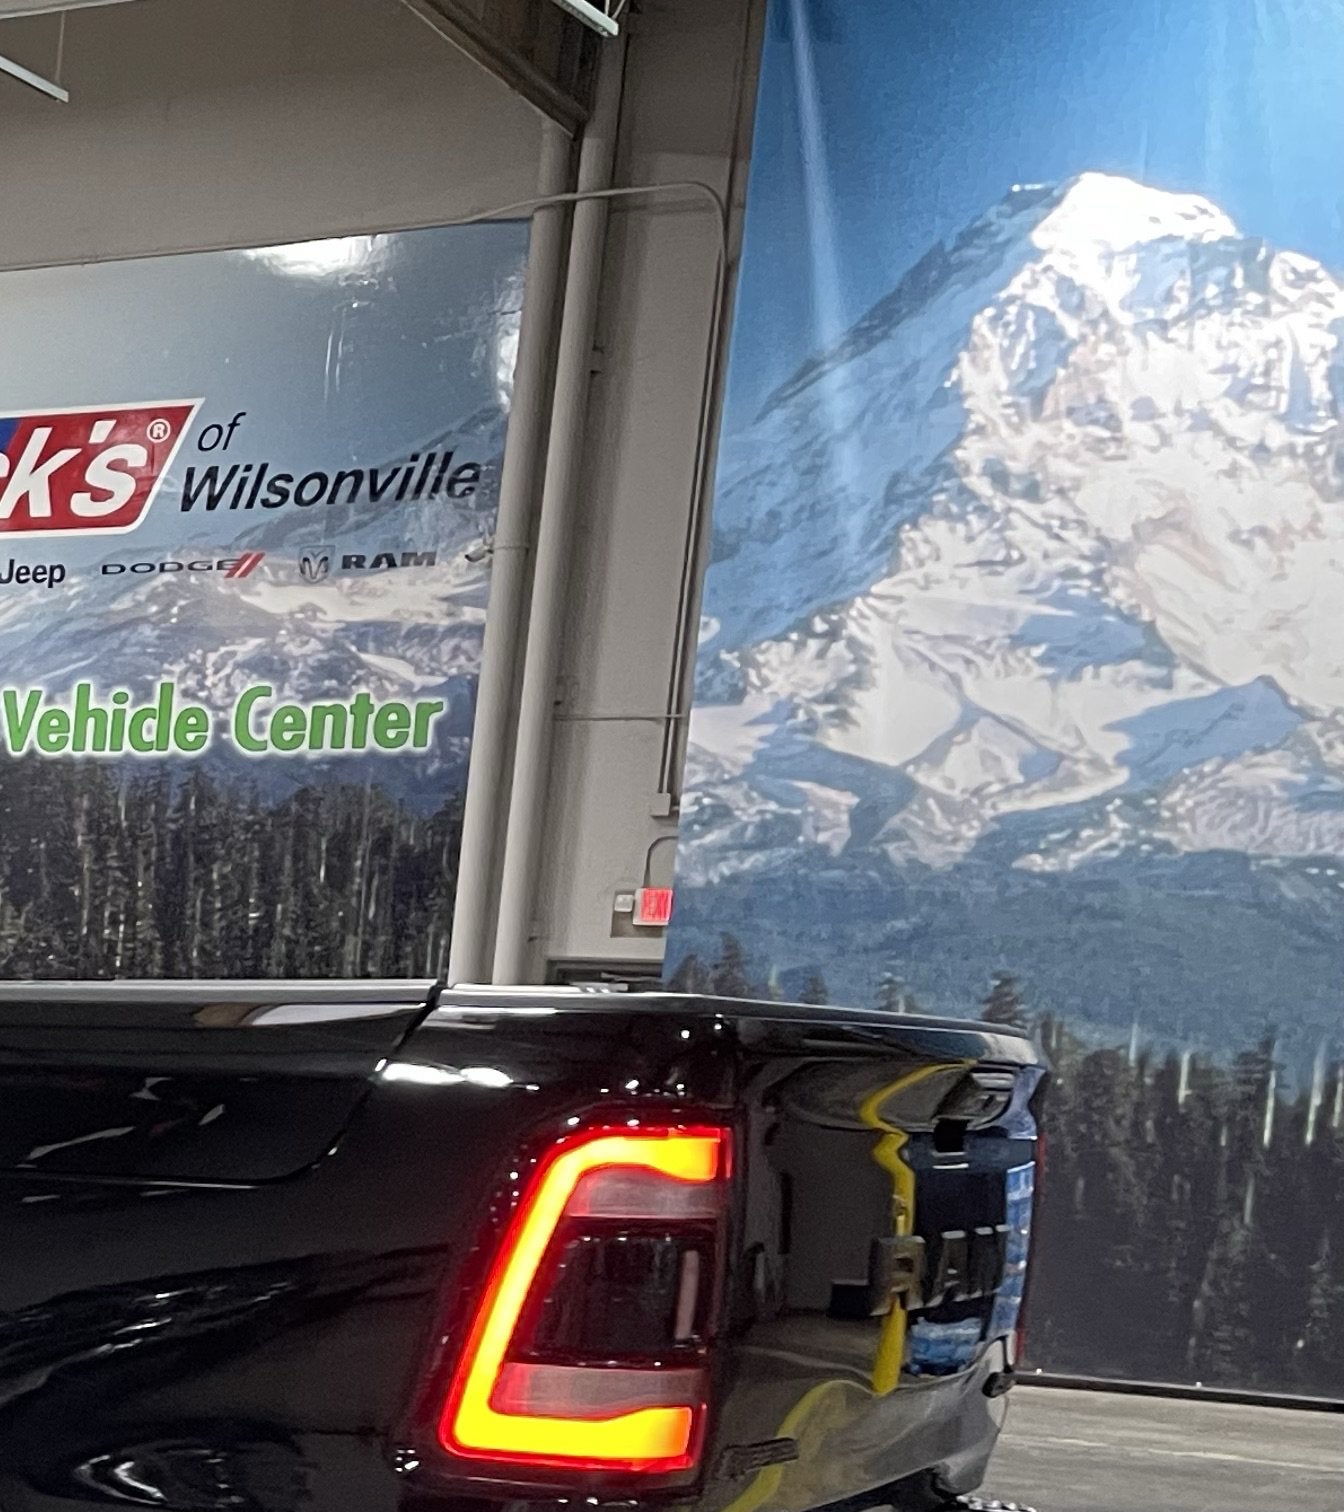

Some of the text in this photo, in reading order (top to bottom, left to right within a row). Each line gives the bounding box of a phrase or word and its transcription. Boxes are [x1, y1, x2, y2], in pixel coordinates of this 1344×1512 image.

[197, 411, 247, 452] of
[179, 452, 480, 513] Wilsonville
[101, 559, 239, 575] DODGE
[341, 550, 437, 571] RAM
[2, 683, 210, 755] Vehicle
[234, 686, 444, 752] Center
